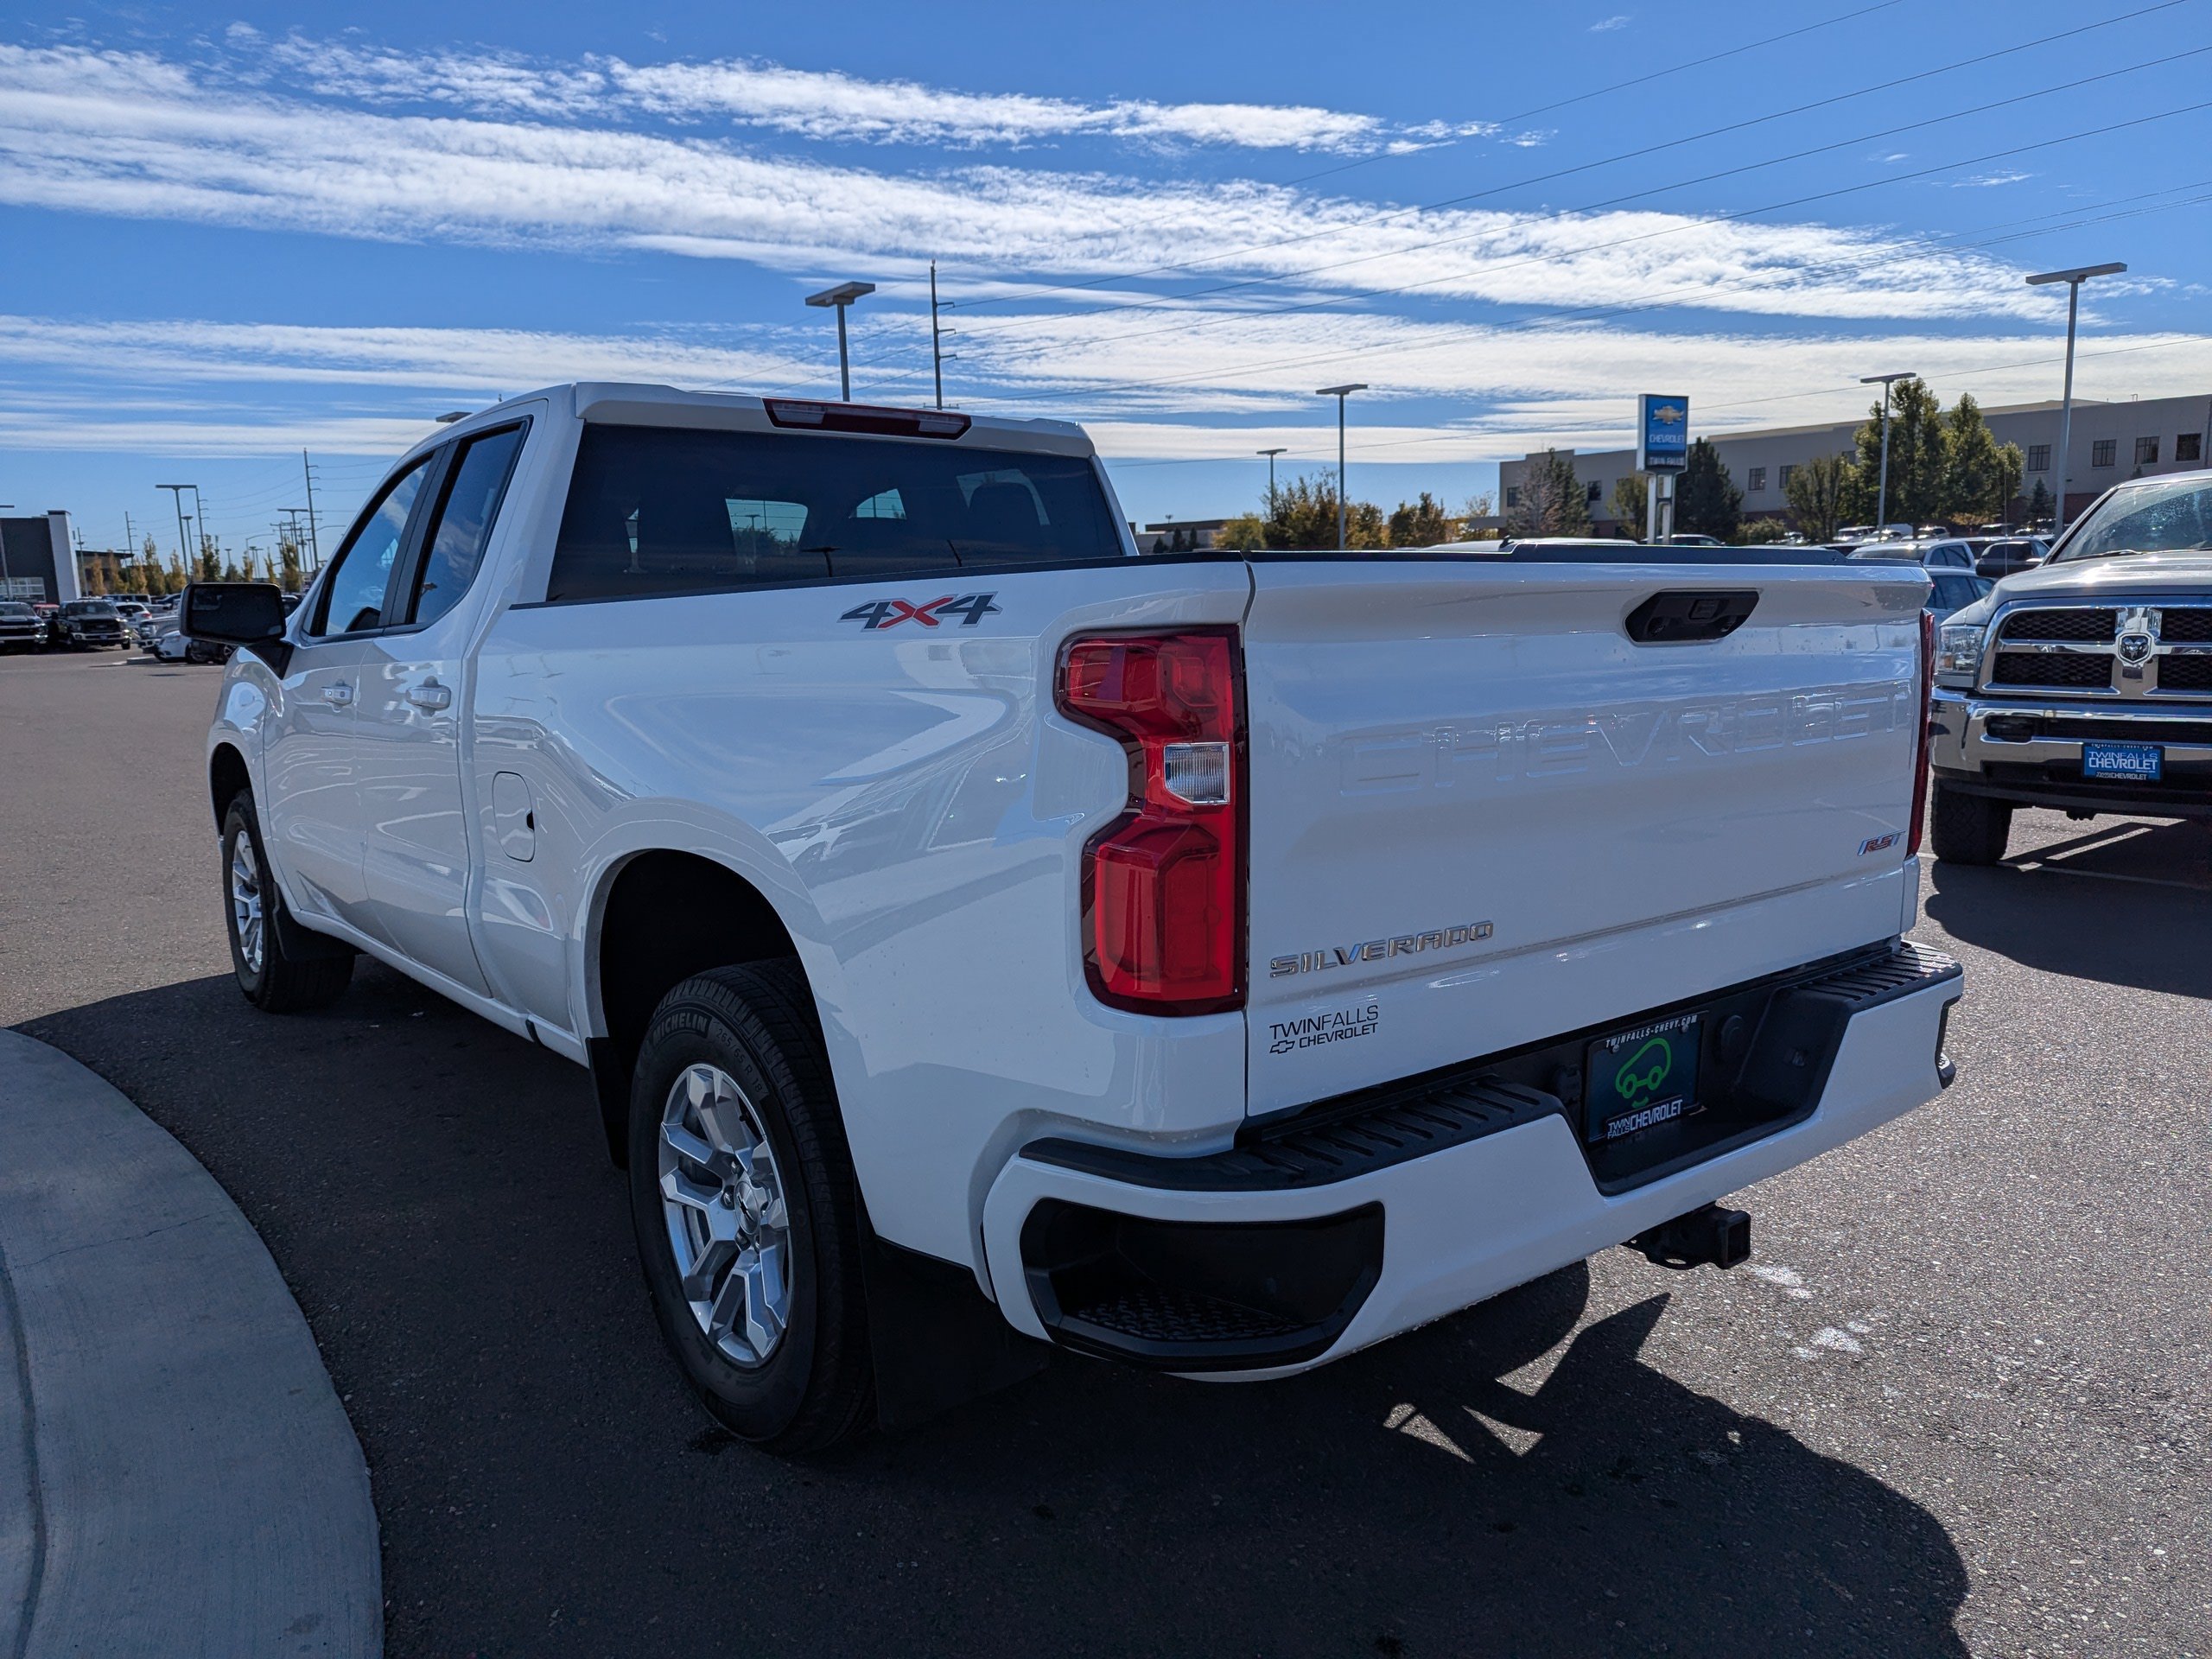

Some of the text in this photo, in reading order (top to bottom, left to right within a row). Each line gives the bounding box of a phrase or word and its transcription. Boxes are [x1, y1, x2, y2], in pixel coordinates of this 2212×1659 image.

[1338, 679, 1912, 797] CHEVROLET
[2089, 758, 2158, 770] CHEVROLET
[1857, 830, 1906, 856] RST
[1269, 920, 1494, 978] SILVERADO
[652, 1011, 709, 1046] MICHELIN
[1269, 1004, 1379, 1039] TWINFALLS
[1299, 1022, 1379, 1049] CHEVROLET
[1605, 1014, 1698, 1048] TWINFALLS-CHEVY.COM
[715, 1027, 745, 1065] 265/65
[1607, 1126, 1630, 1139] FALLS
[1608, 1099, 1683, 1134] TWIN CHEVROLET
